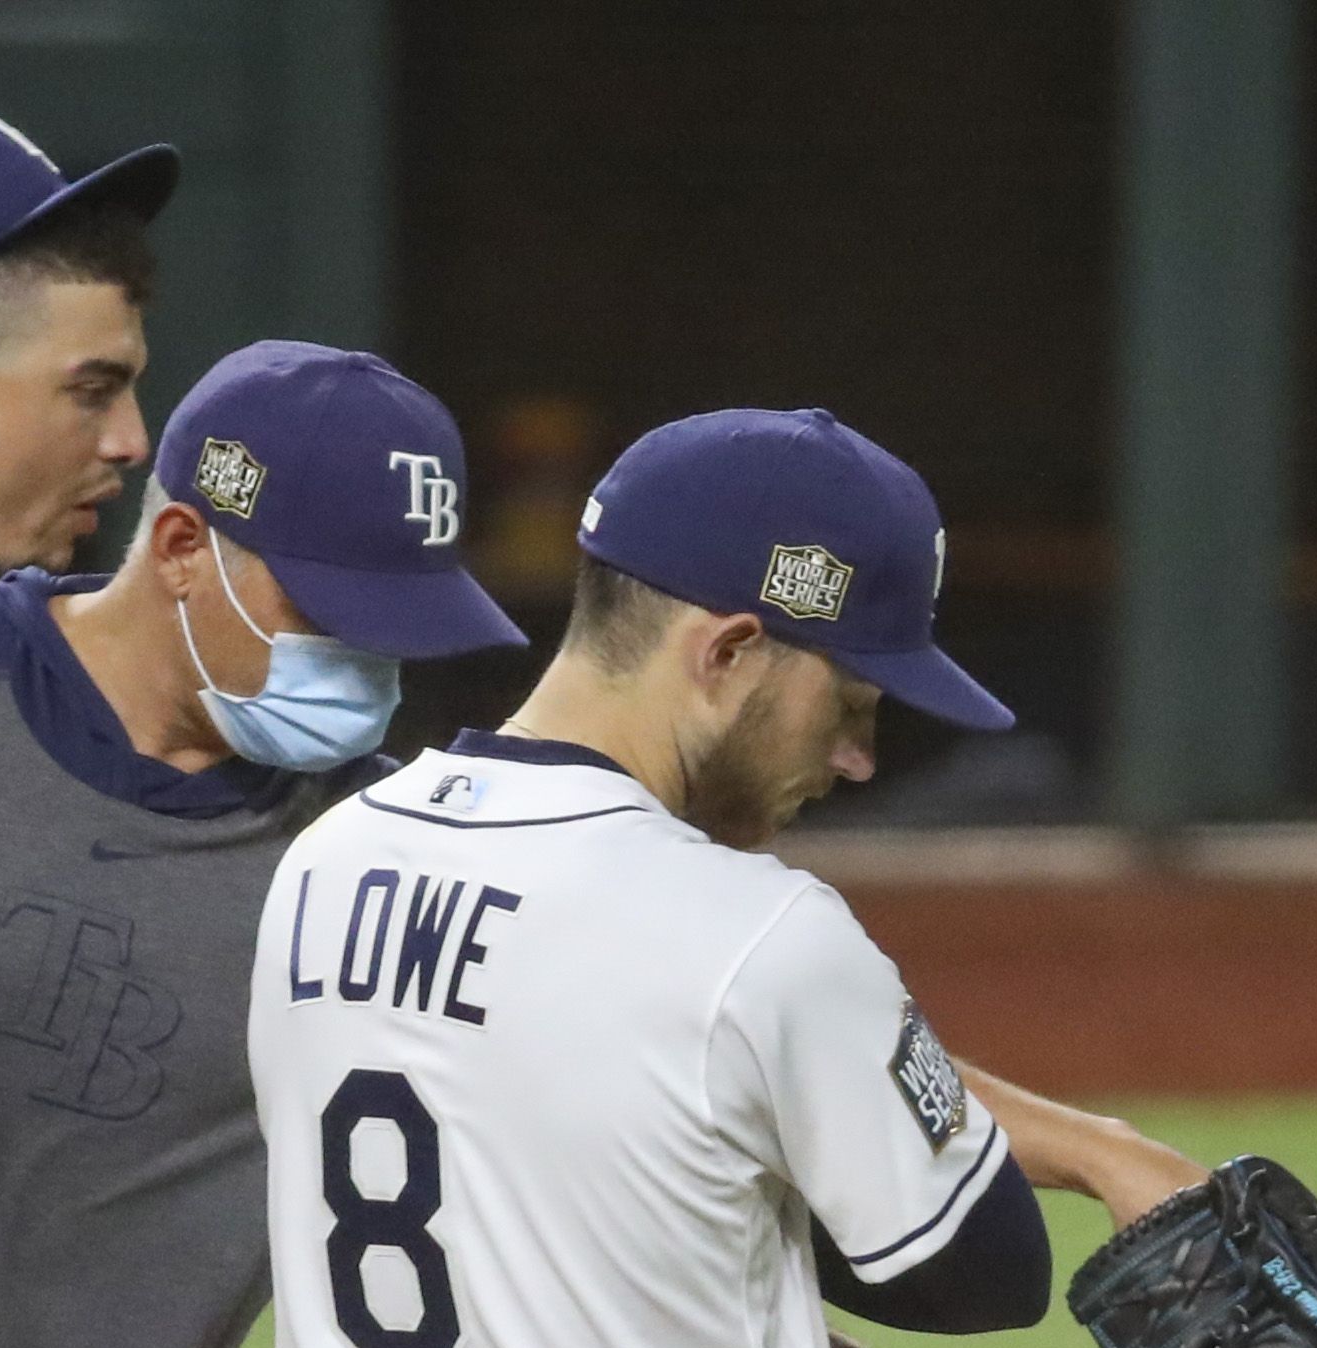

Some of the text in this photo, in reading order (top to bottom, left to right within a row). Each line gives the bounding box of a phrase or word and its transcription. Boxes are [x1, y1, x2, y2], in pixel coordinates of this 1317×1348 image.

[198, 463, 250, 510] SERIES
[206, 447, 259, 490] WORLD
[389, 450, 460, 546] TB
[768, 574, 841, 611] SERIES
[776, 554, 845, 592] WORLD
[289, 867, 524, 1027] LOWE
